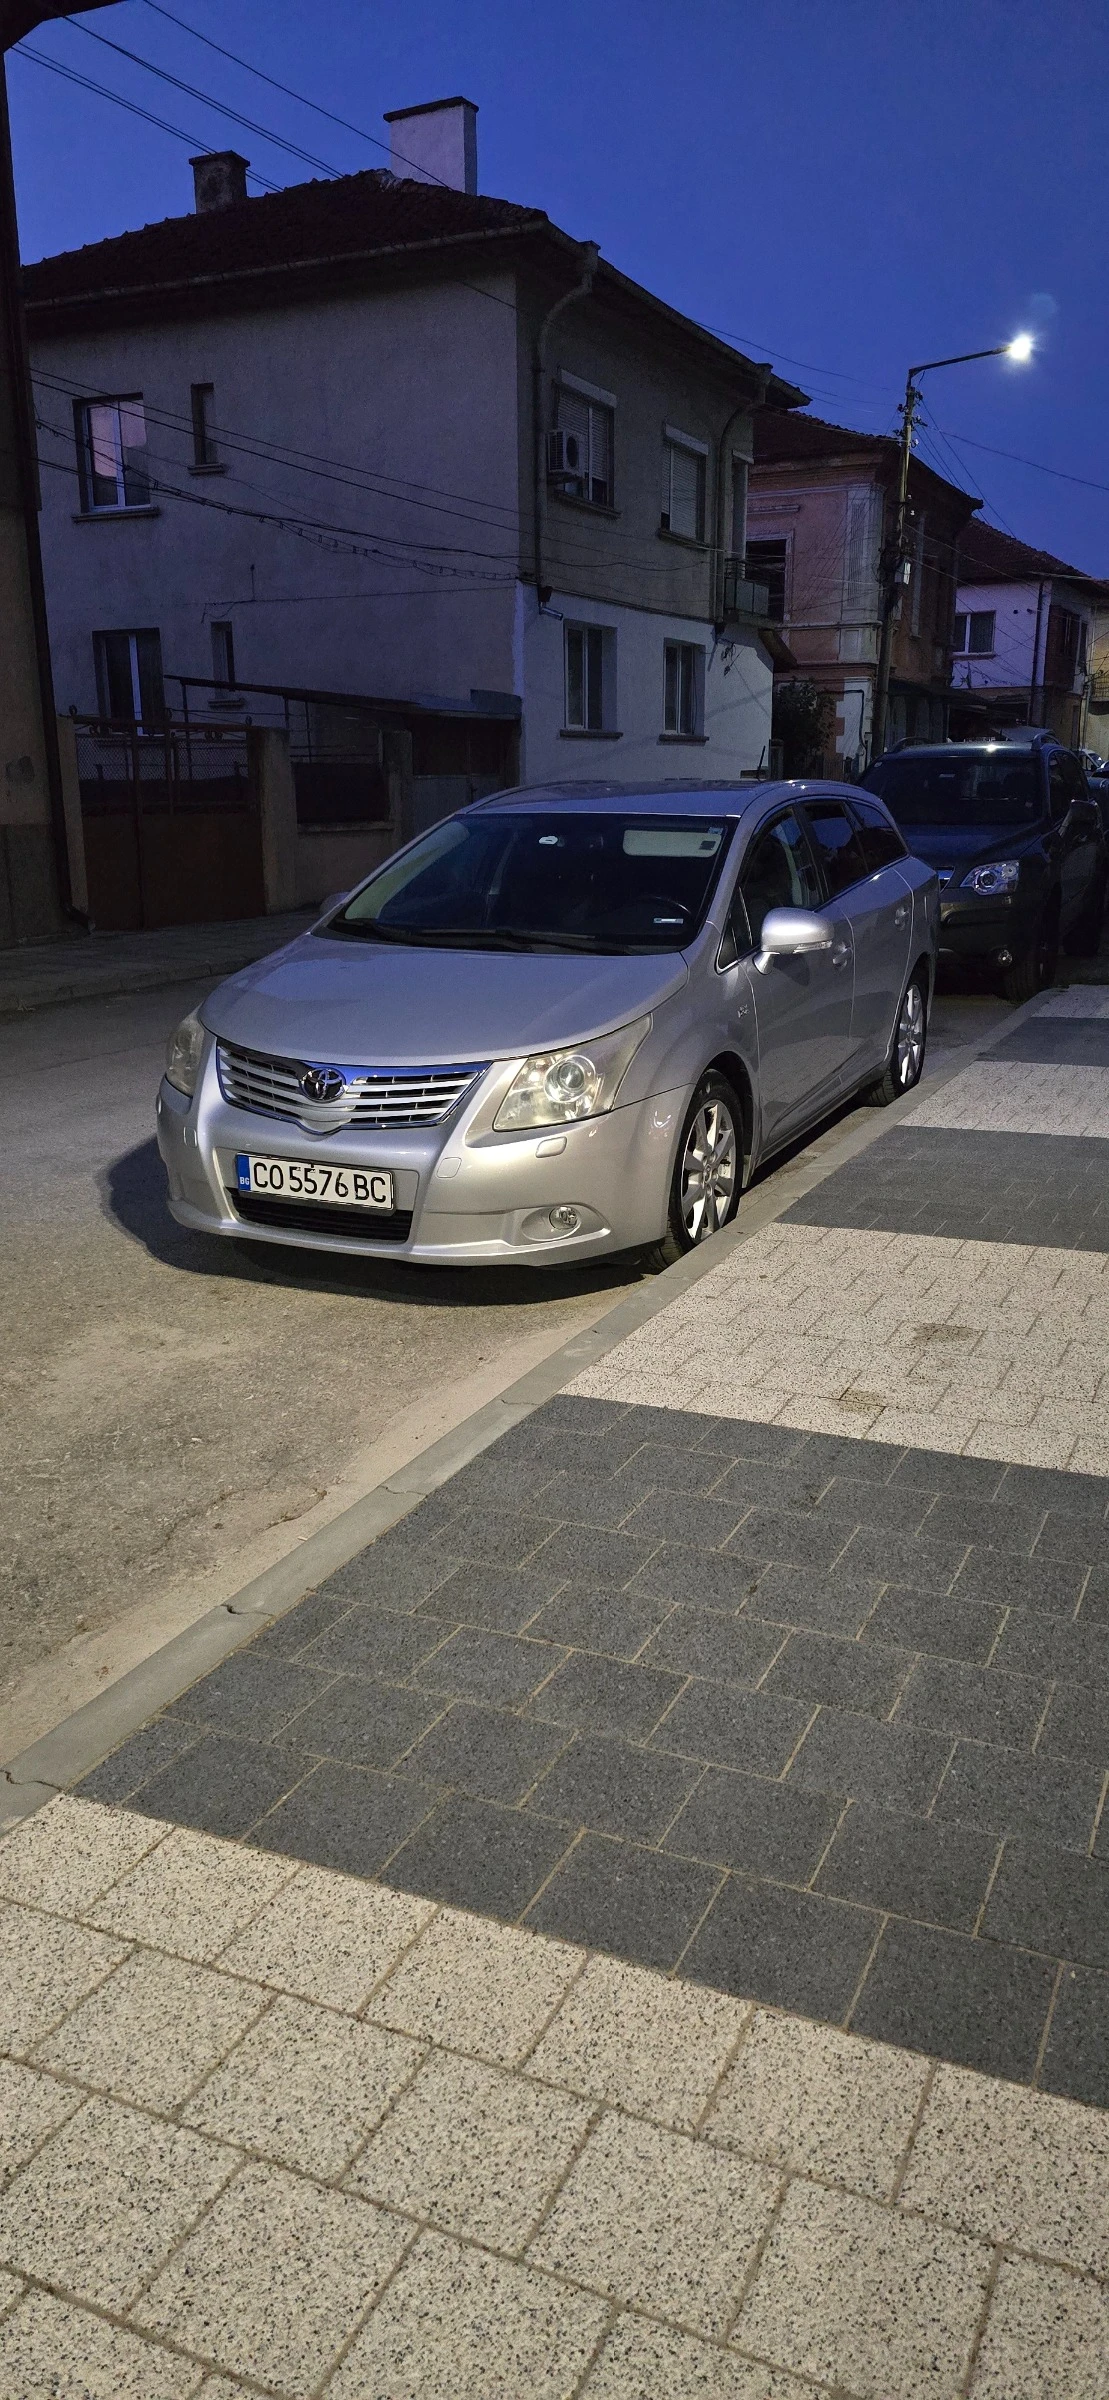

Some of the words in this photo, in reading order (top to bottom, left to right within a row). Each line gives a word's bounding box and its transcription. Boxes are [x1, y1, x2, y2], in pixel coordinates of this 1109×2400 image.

[239, 1176, 250, 1185] BG
[253, 1162, 284, 1190] CO
[289, 1166, 349, 1198] 5576
[353, 1174, 387, 1203] BC
